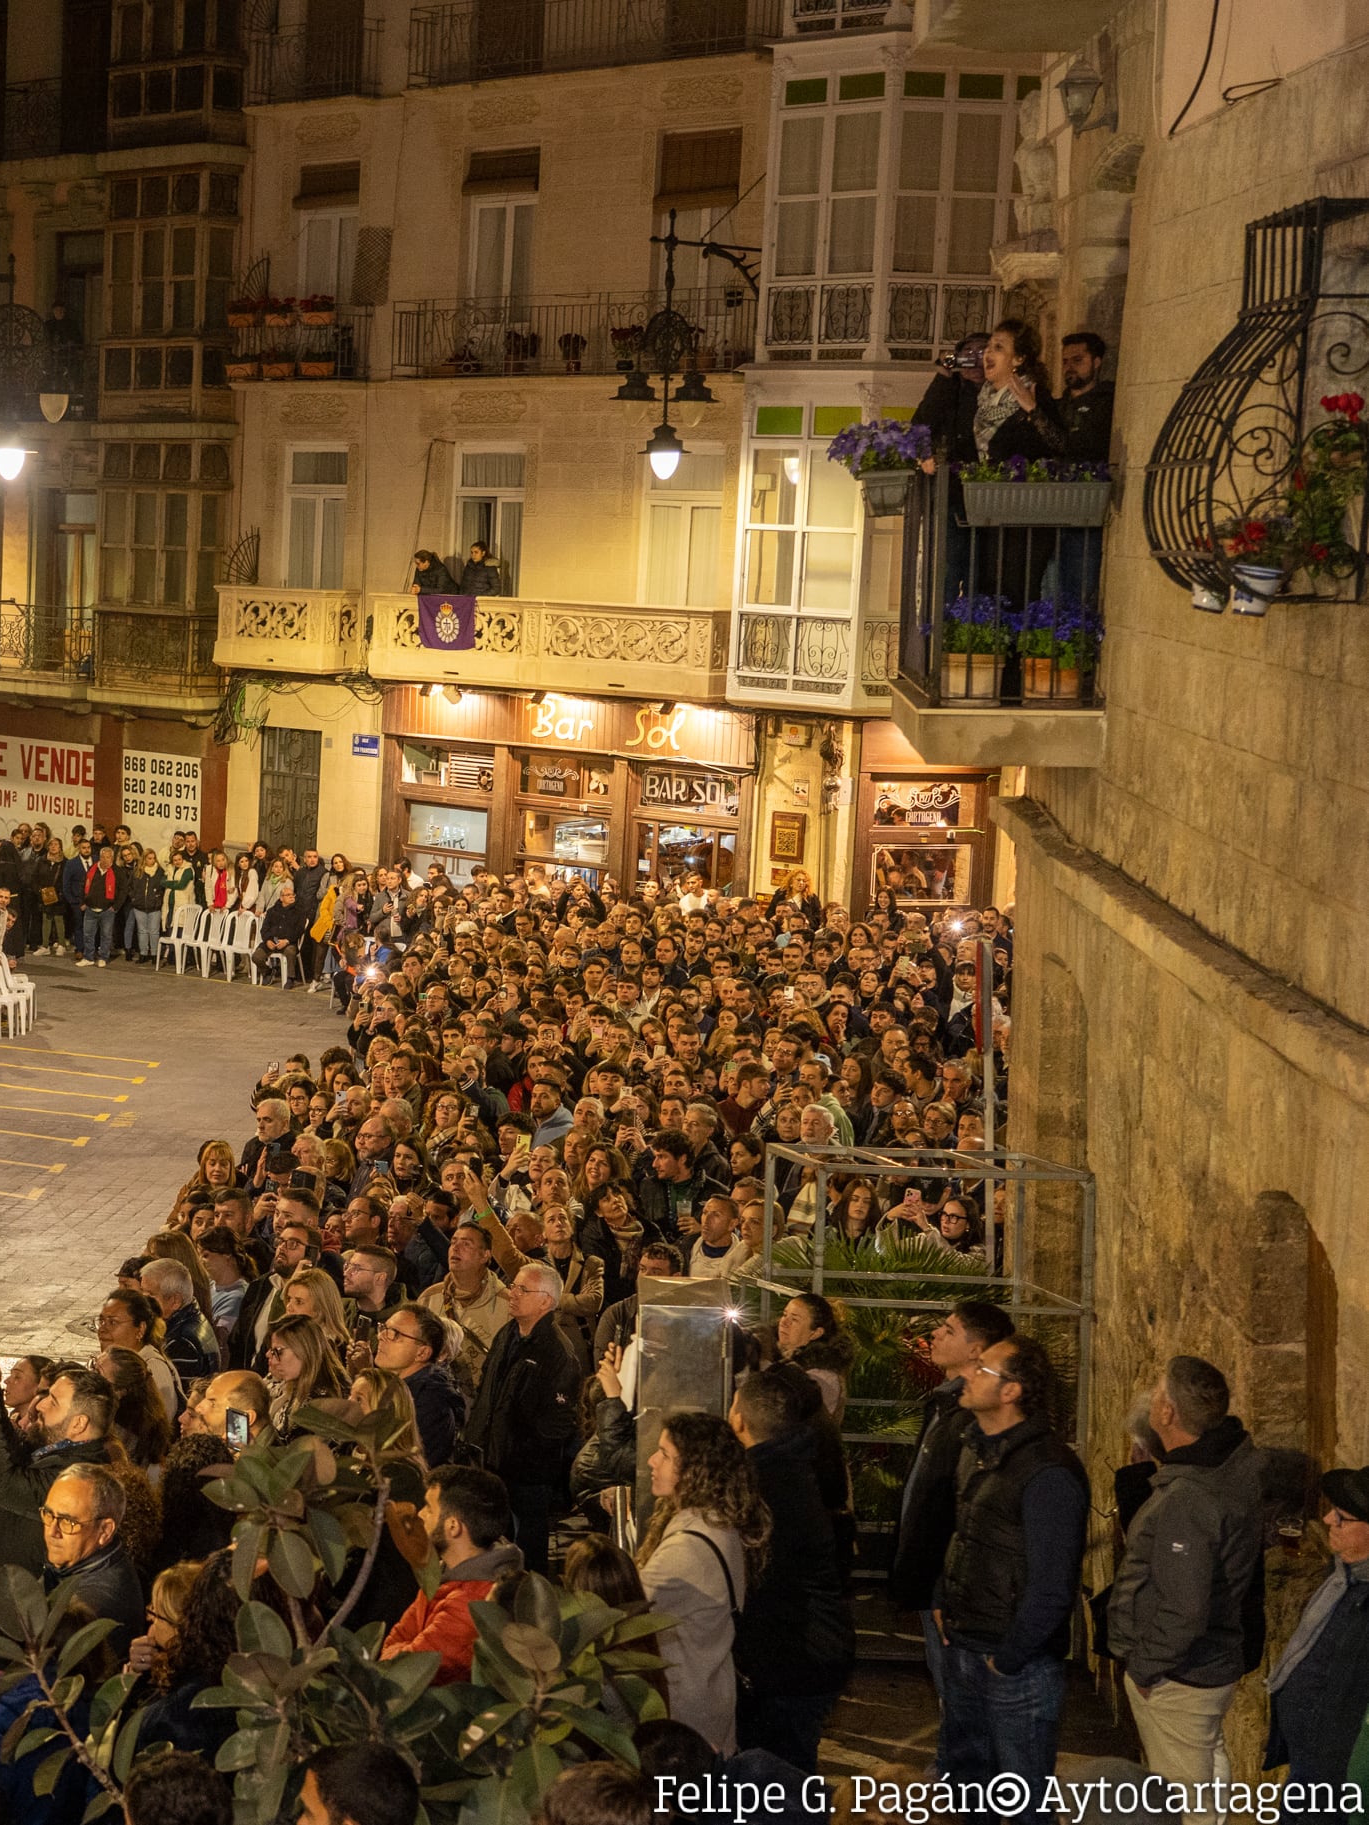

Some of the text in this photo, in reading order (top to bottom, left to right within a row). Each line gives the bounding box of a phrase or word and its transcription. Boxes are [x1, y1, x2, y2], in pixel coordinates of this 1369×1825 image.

[527, 700, 686, 750] Bar Sol
[20, 744, 95, 787] VENDE
[124, 756, 198, 778] 868 062 206
[124, 777, 196, 800] 620 240 971
[646, 774, 729, 805] BAR SOL
[27, 792, 93, 819] DIVISIBLE
[124, 798, 198, 822] 620 240 973
